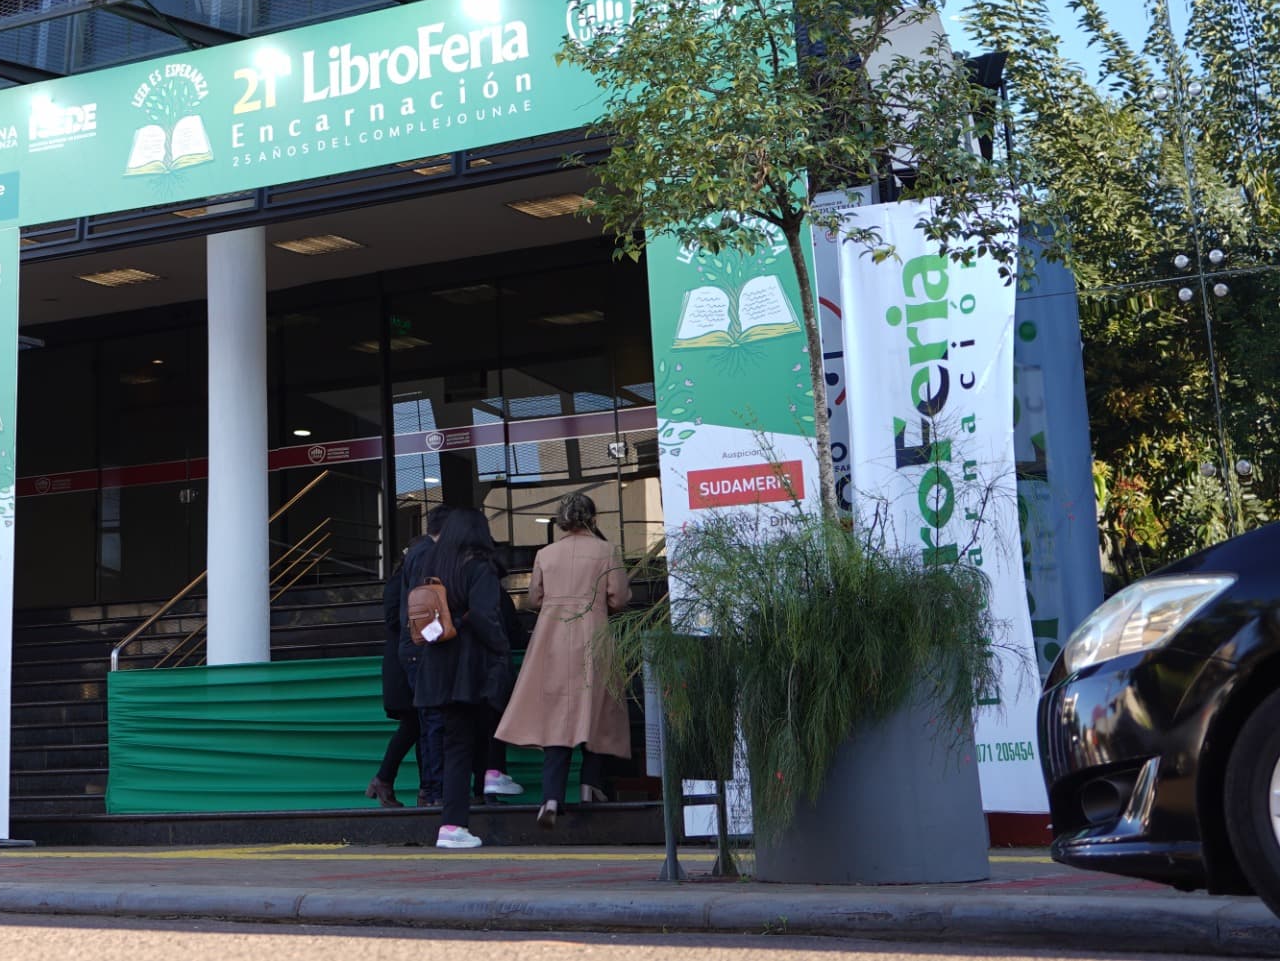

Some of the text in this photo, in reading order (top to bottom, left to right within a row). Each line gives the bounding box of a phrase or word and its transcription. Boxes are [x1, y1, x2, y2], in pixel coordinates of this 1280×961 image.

[131, 63, 209, 108] LEER ES ESPERANZA
[232, 19, 530, 115] 21 LibroFeria
[231, 71, 533, 149] Encarnación
[232, 99, 533, 167] 25 AÑOS DEL COMPLEJO UNAE
[885, 254, 959, 567] roFeria
[995, 741, 1035, 762] 205454
